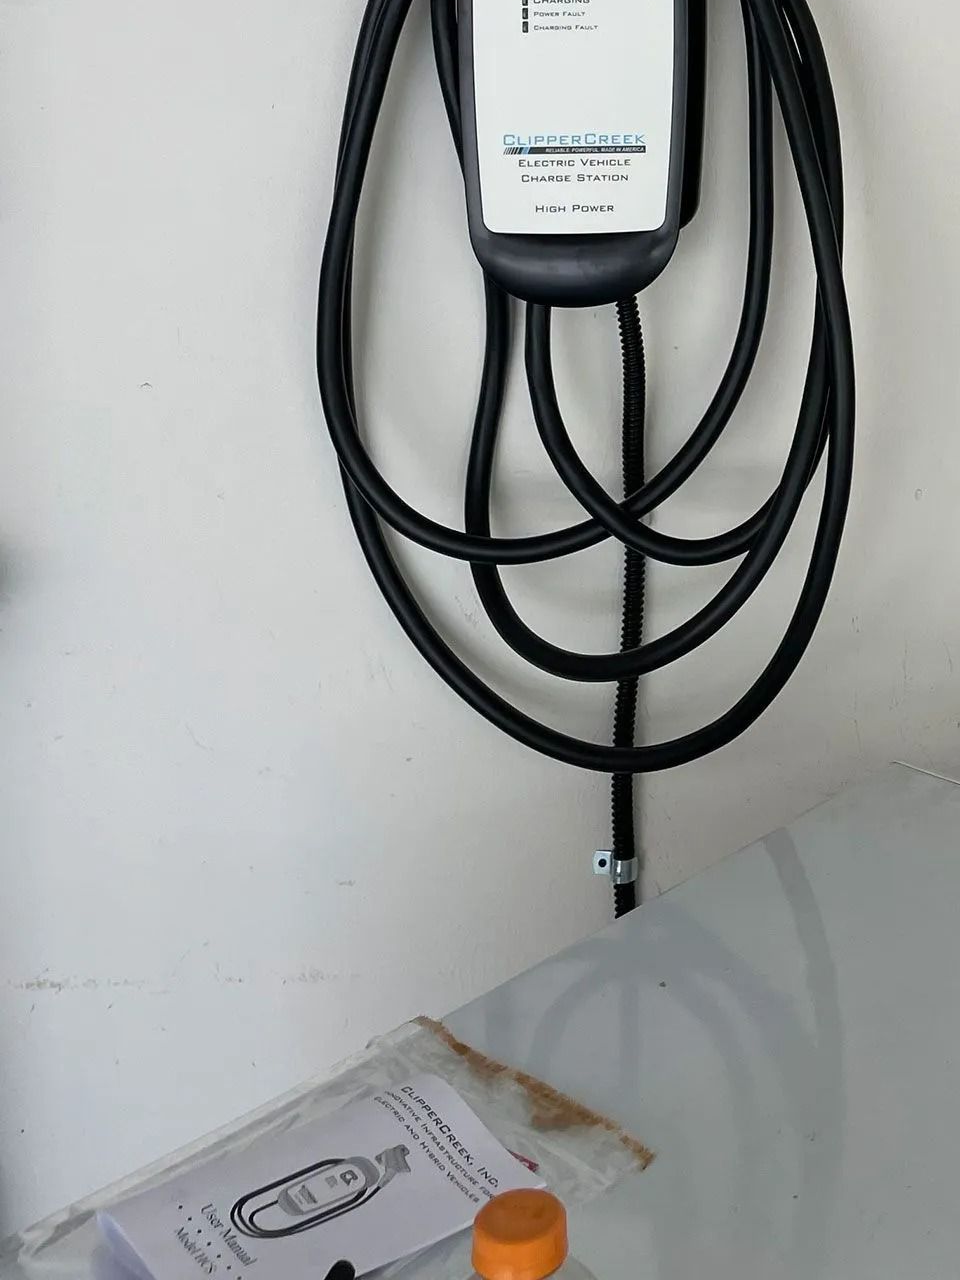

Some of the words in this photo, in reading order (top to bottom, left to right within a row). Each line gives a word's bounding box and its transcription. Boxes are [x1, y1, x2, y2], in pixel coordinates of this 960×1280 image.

[503, 133, 646, 146] CLIPPERCREEK
[518, 159, 575, 168] ELECTRIC
[580, 158, 631, 167] VEHICLE
[521, 174, 571, 183] CHARGE
[577, 174, 629, 182] STATION
[535, 205, 566, 213] HIGH
[572, 204, 614, 213] POWER
[400, 1085, 475, 1166] CLIPPERCREEK,
[477, 1166, 499, 1188] INC.
[404, 1124, 420, 1141] AND
[419, 1140, 446, 1172] HYBRID
[200, 1202, 225, 1229] User
[218, 1227, 259, 1267] Manual
